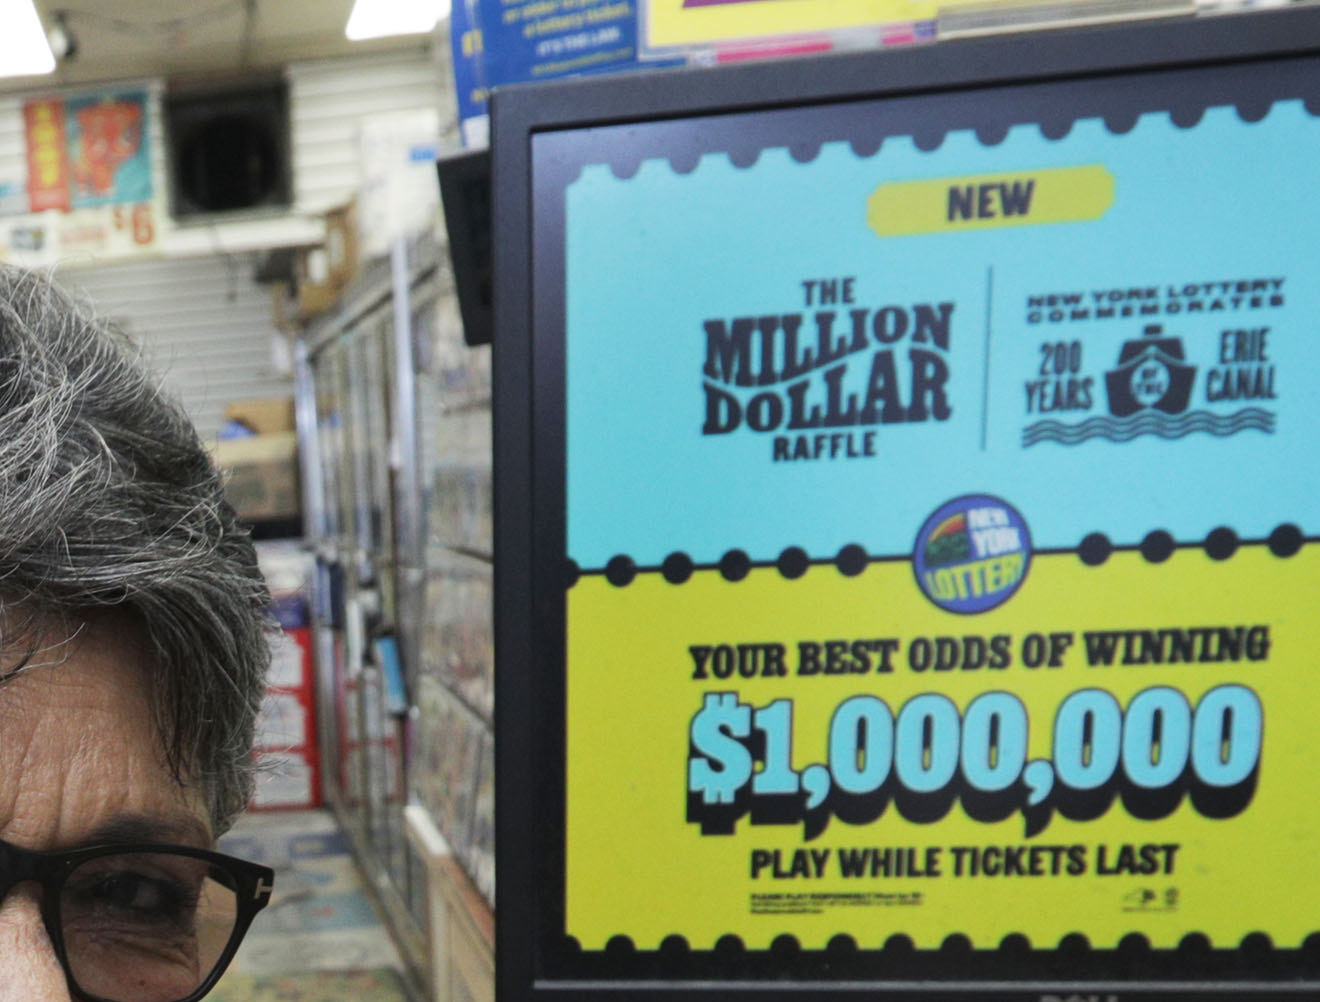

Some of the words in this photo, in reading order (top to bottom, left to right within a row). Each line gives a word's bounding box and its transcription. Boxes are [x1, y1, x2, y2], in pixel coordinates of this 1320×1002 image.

[947, 180, 1035, 222] NEW
[802, 277, 856, 306] THE
[1026, 294, 1286, 323] COMMEMORATES
[1027, 292, 1083, 308] NEW
[1092, 286, 1160, 302] YORK
[1168, 276, 1286, 298] LOTTERY
[702, 302, 955, 388] MILLION
[1039, 339, 1083, 376] 200
[1219, 326, 1272, 365] ERIE
[702, 345, 953, 436] DOLLAR
[1024, 377, 1094, 414] YEARS
[1206, 365, 1279, 403] CANAL
[772, 431, 877, 462] RAFFLE
[967, 507, 1011, 530] NEW
[970, 526, 1022, 558] YORK
[924, 552, 1027, 602] LOTTERY
[689, 641, 787, 680] YOUR
[796, 638, 899, 677] BEST
[907, 634, 1014, 672] ODDS
[1021, 632, 1075, 670] OF
[1082, 625, 1272, 667] WINNING
[686, 682, 1265, 840] $1,000,000
[750, 847, 830, 880] PLAY
[838, 846, 941, 878] WHILE
[949, 844, 1088, 876] TICKETS
[1096, 843, 1181, 874] LAST
